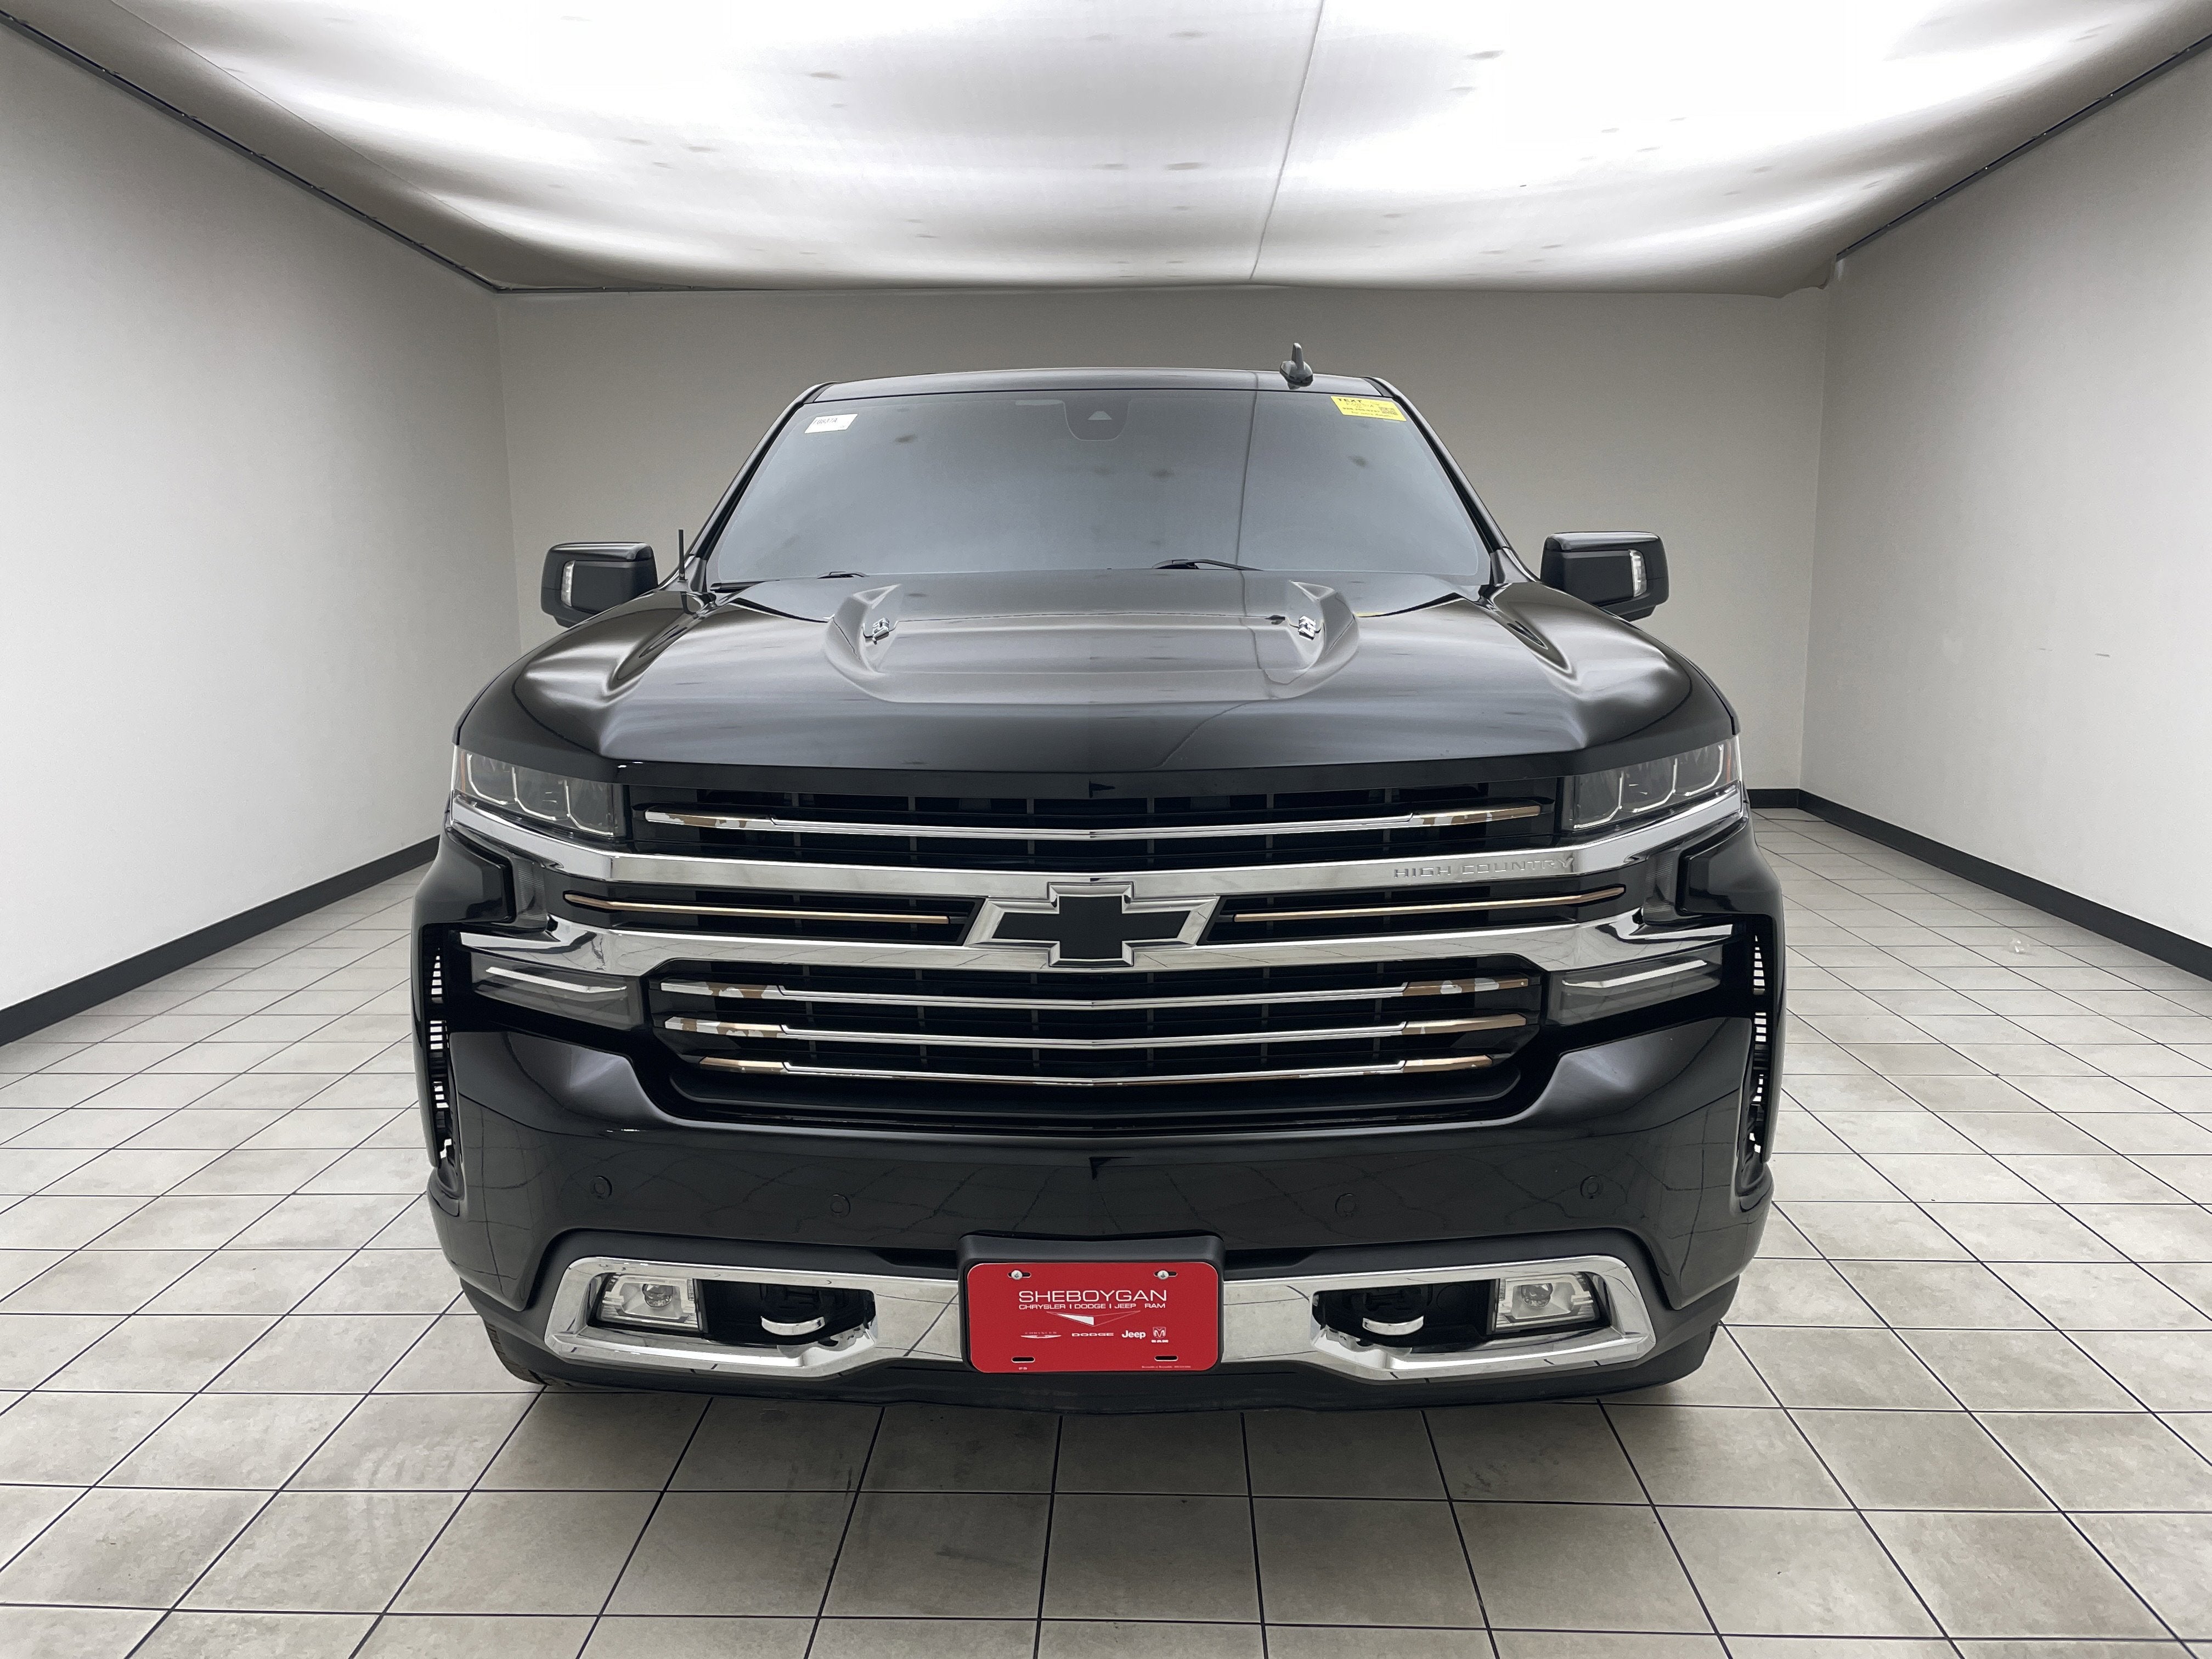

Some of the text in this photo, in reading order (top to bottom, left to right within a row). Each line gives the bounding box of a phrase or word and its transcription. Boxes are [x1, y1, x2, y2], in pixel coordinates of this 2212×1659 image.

[1394, 857, 1574, 878] HIGH COUNTRY
[1019, 1290, 1167, 1302] SHEBOYGAN
[1121, 1330, 1146, 1339] Jeep
